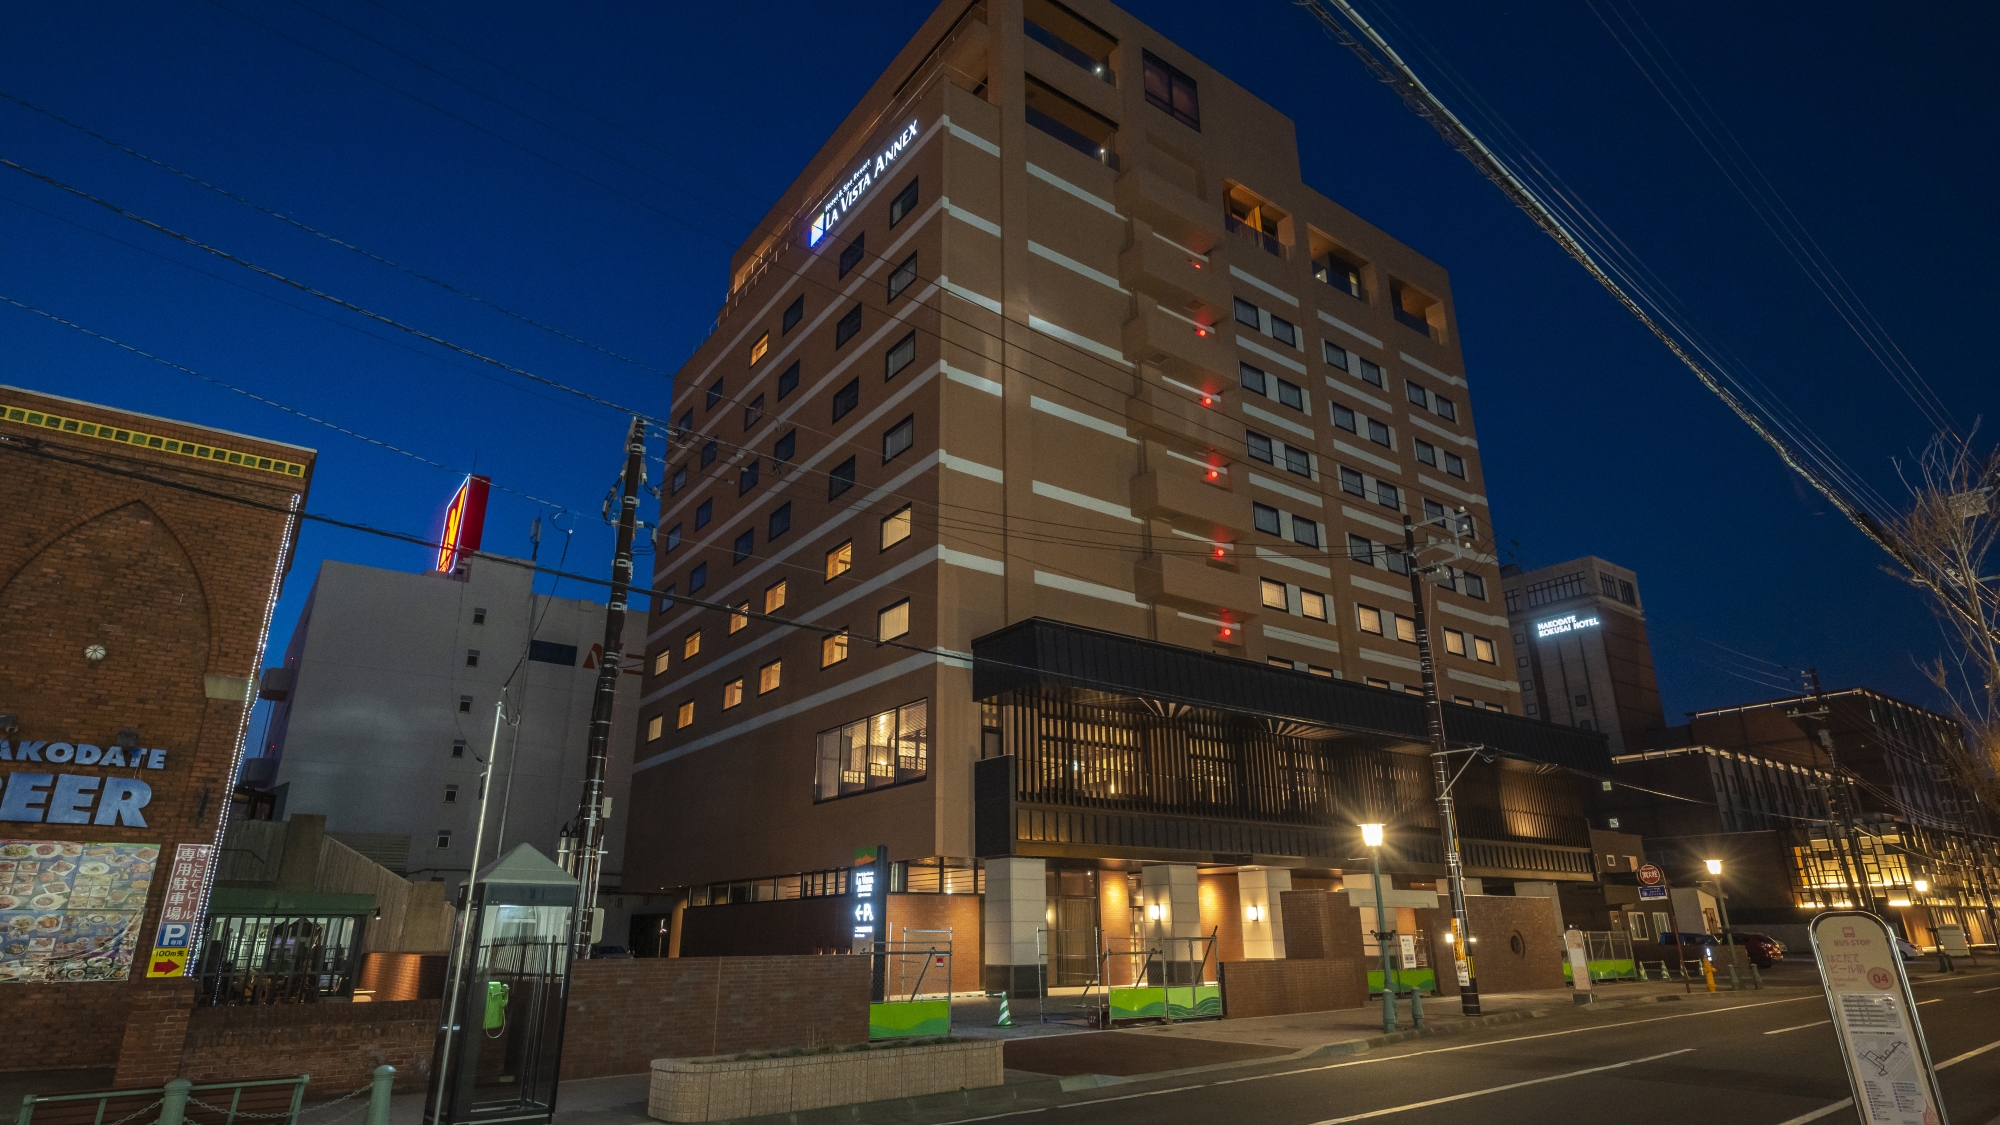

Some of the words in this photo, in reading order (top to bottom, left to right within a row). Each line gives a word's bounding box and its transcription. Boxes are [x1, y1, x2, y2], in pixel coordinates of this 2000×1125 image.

[825, 208, 839, 231] LA
[840, 172, 871, 212] VISTA
[874, 119, 918, 179] ANNEX
[1537, 615, 1577, 631] HAKODATE
[1538, 623, 1572, 638] KOKUSAI
[1573, 617, 1599, 630] HOTEL
[0, 772, 152, 828] EER
[164, 848, 197, 921] 専用駐車場
[180, 848, 209, 921] はこだてビール
[162, 924, 187, 946] P
[1833, 939, 1850, 947] BUS
[1850, 938, 1872, 946] STOP
[1826, 953, 1860, 963] はこだて
[1829, 963, 1866, 975] ビール前
[1872, 973, 1889, 984] 04
